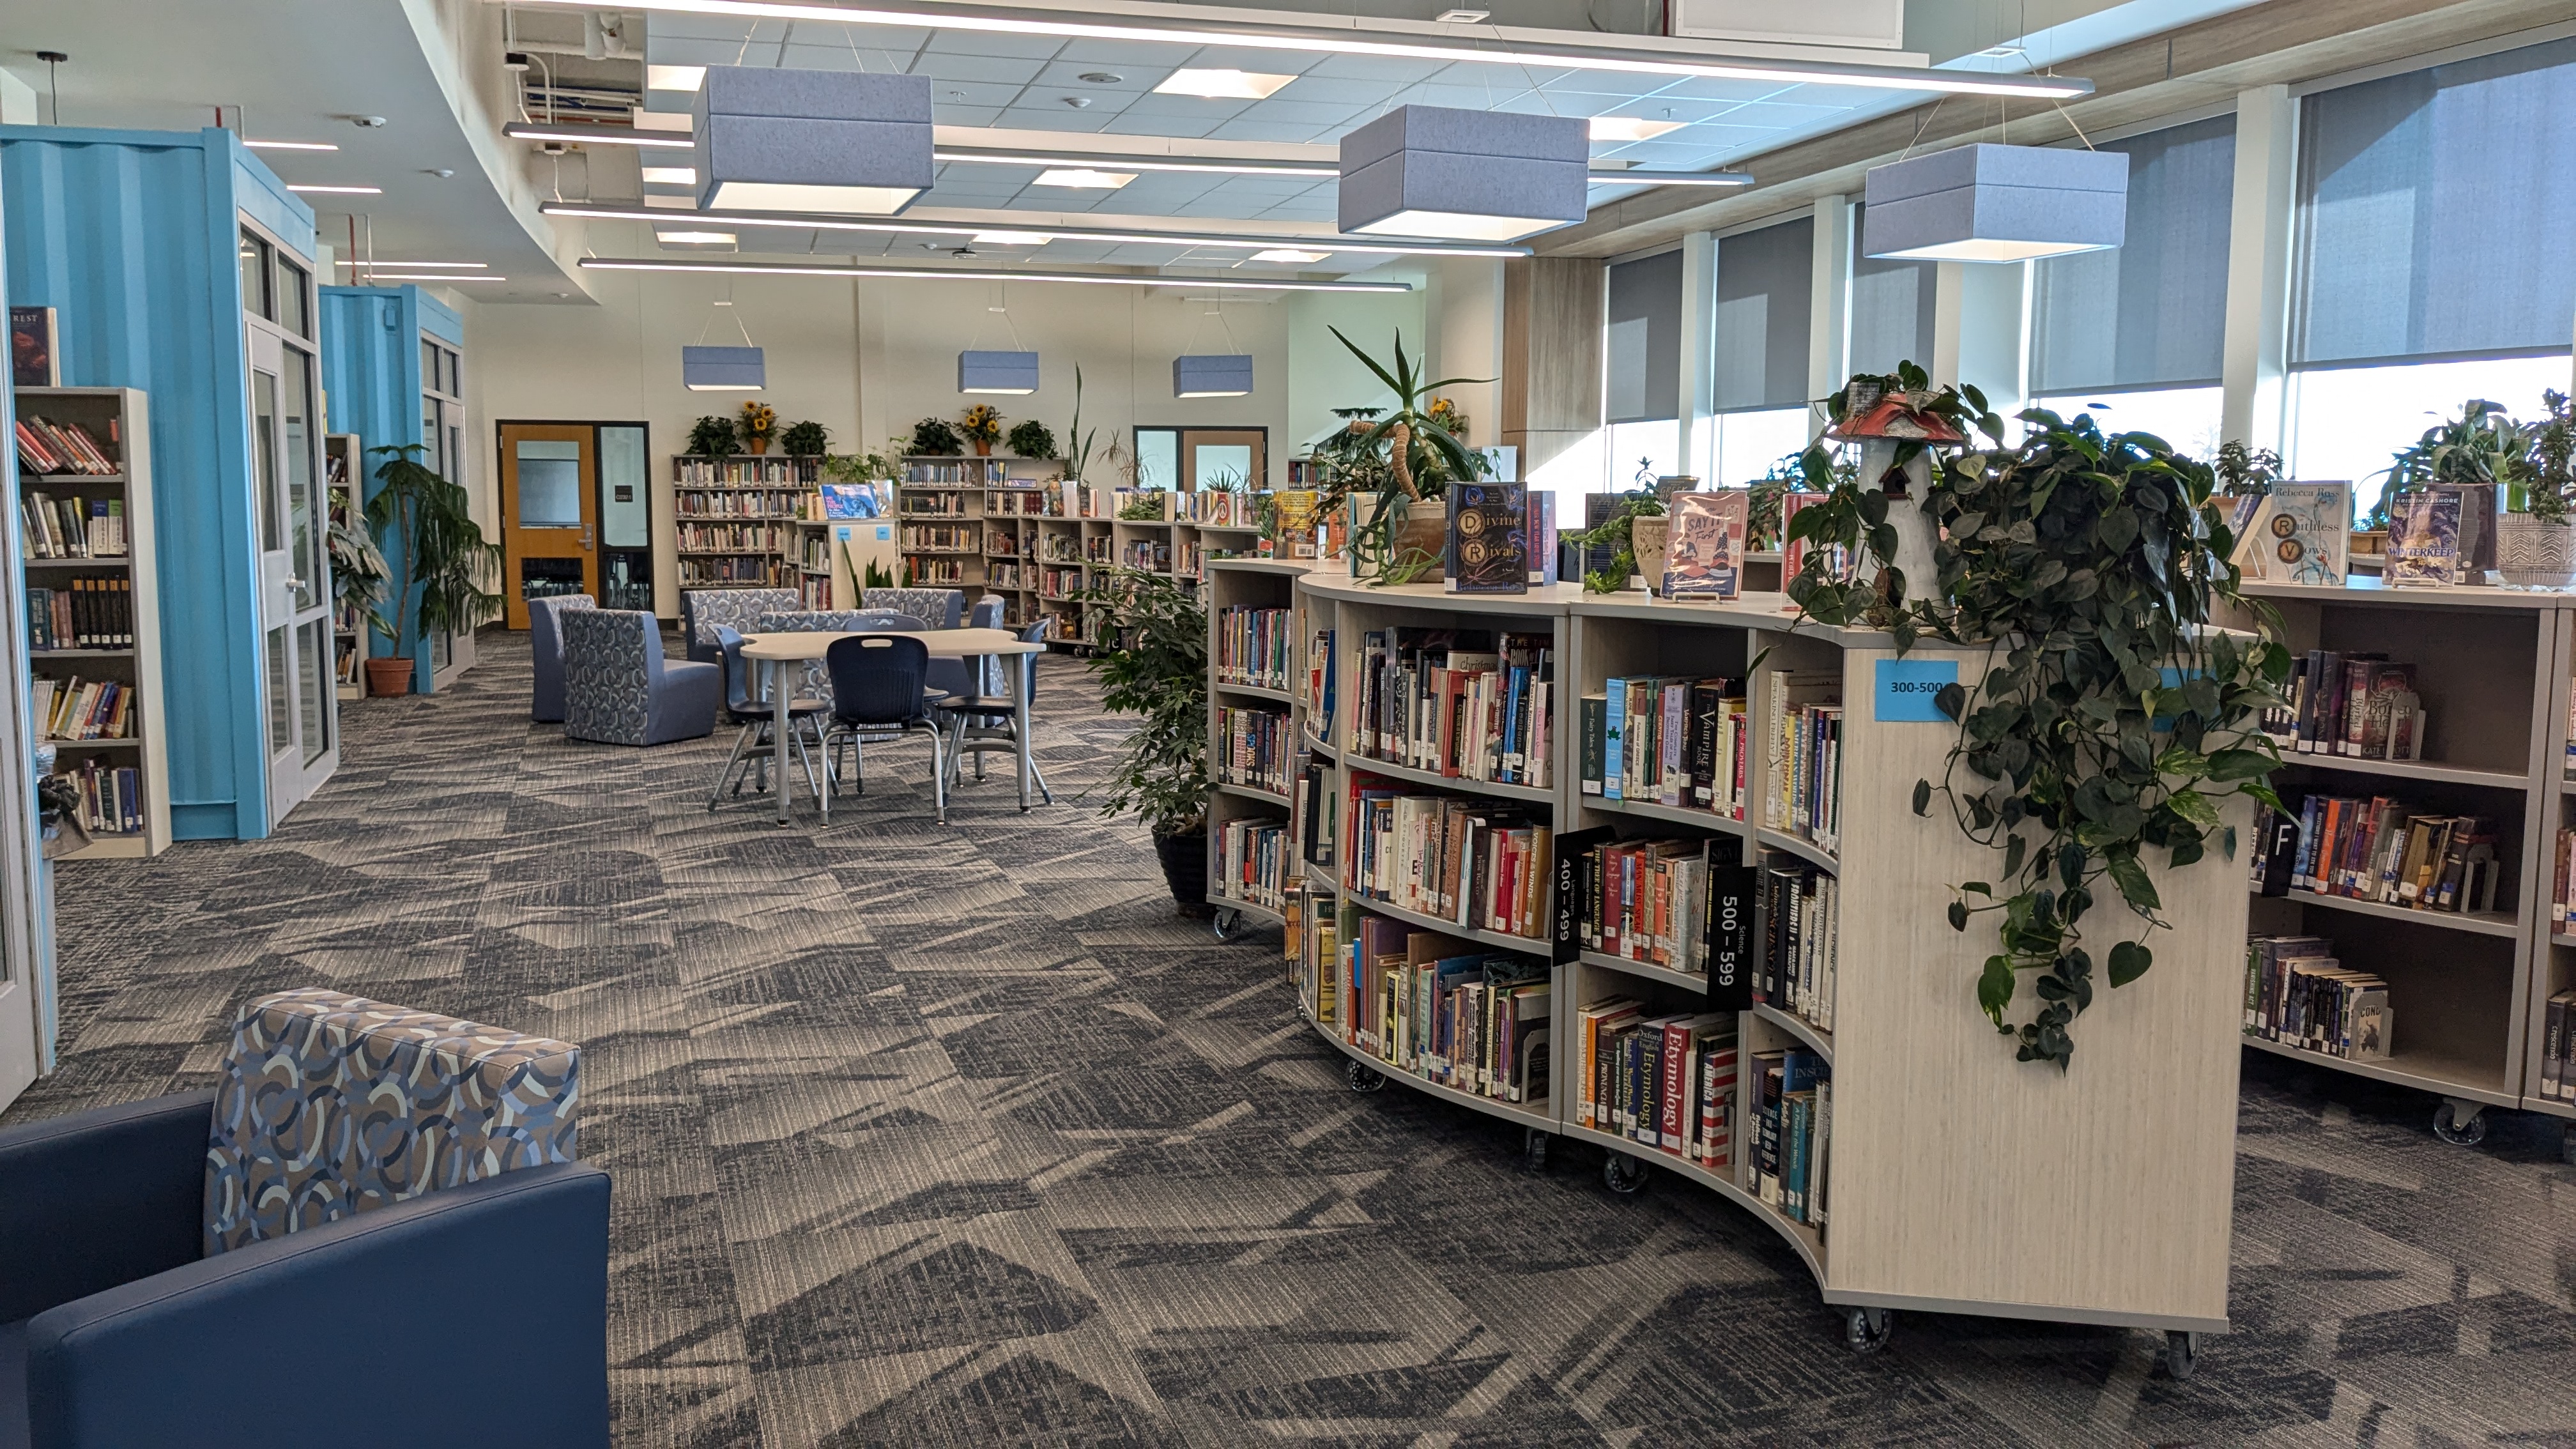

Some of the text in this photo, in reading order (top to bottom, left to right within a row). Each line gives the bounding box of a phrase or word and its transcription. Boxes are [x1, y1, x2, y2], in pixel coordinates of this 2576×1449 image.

[2276, 487, 2340, 496] Rebecca Ross
[1466, 514, 1521, 529] Divine
[1688, 512, 1723, 532] SAY IT
[2280, 520, 2340, 532] Ruthless
[1695, 528, 1719, 543] First
[1470, 544, 1521, 559] Rivals
[2285, 545, 2327, 556] Vows
[2388, 548, 2455, 557] WINTERKEEP
[1510, 649, 1529, 666] BOOK
[1246, 733, 1255, 766] SPOOKS
[2276, 825, 2292, 856] F
[1594, 884, 1600, 894] OF
[1560, 859, 1570, 941] 400 499
[1719, 896, 1738, 986] 500 599
[1738, 926, 1746, 954] Science
[1638, 1029, 1662, 1041] Oxford
[2550, 1026, 2558, 1059] Crescendo
[1639, 1041, 1659, 1052] English
[1663, 1031, 1682, 1131] Etymology
[1703, 1062, 1713, 1101] AMERICA
[1639, 1052, 1655, 1129] Etymology
